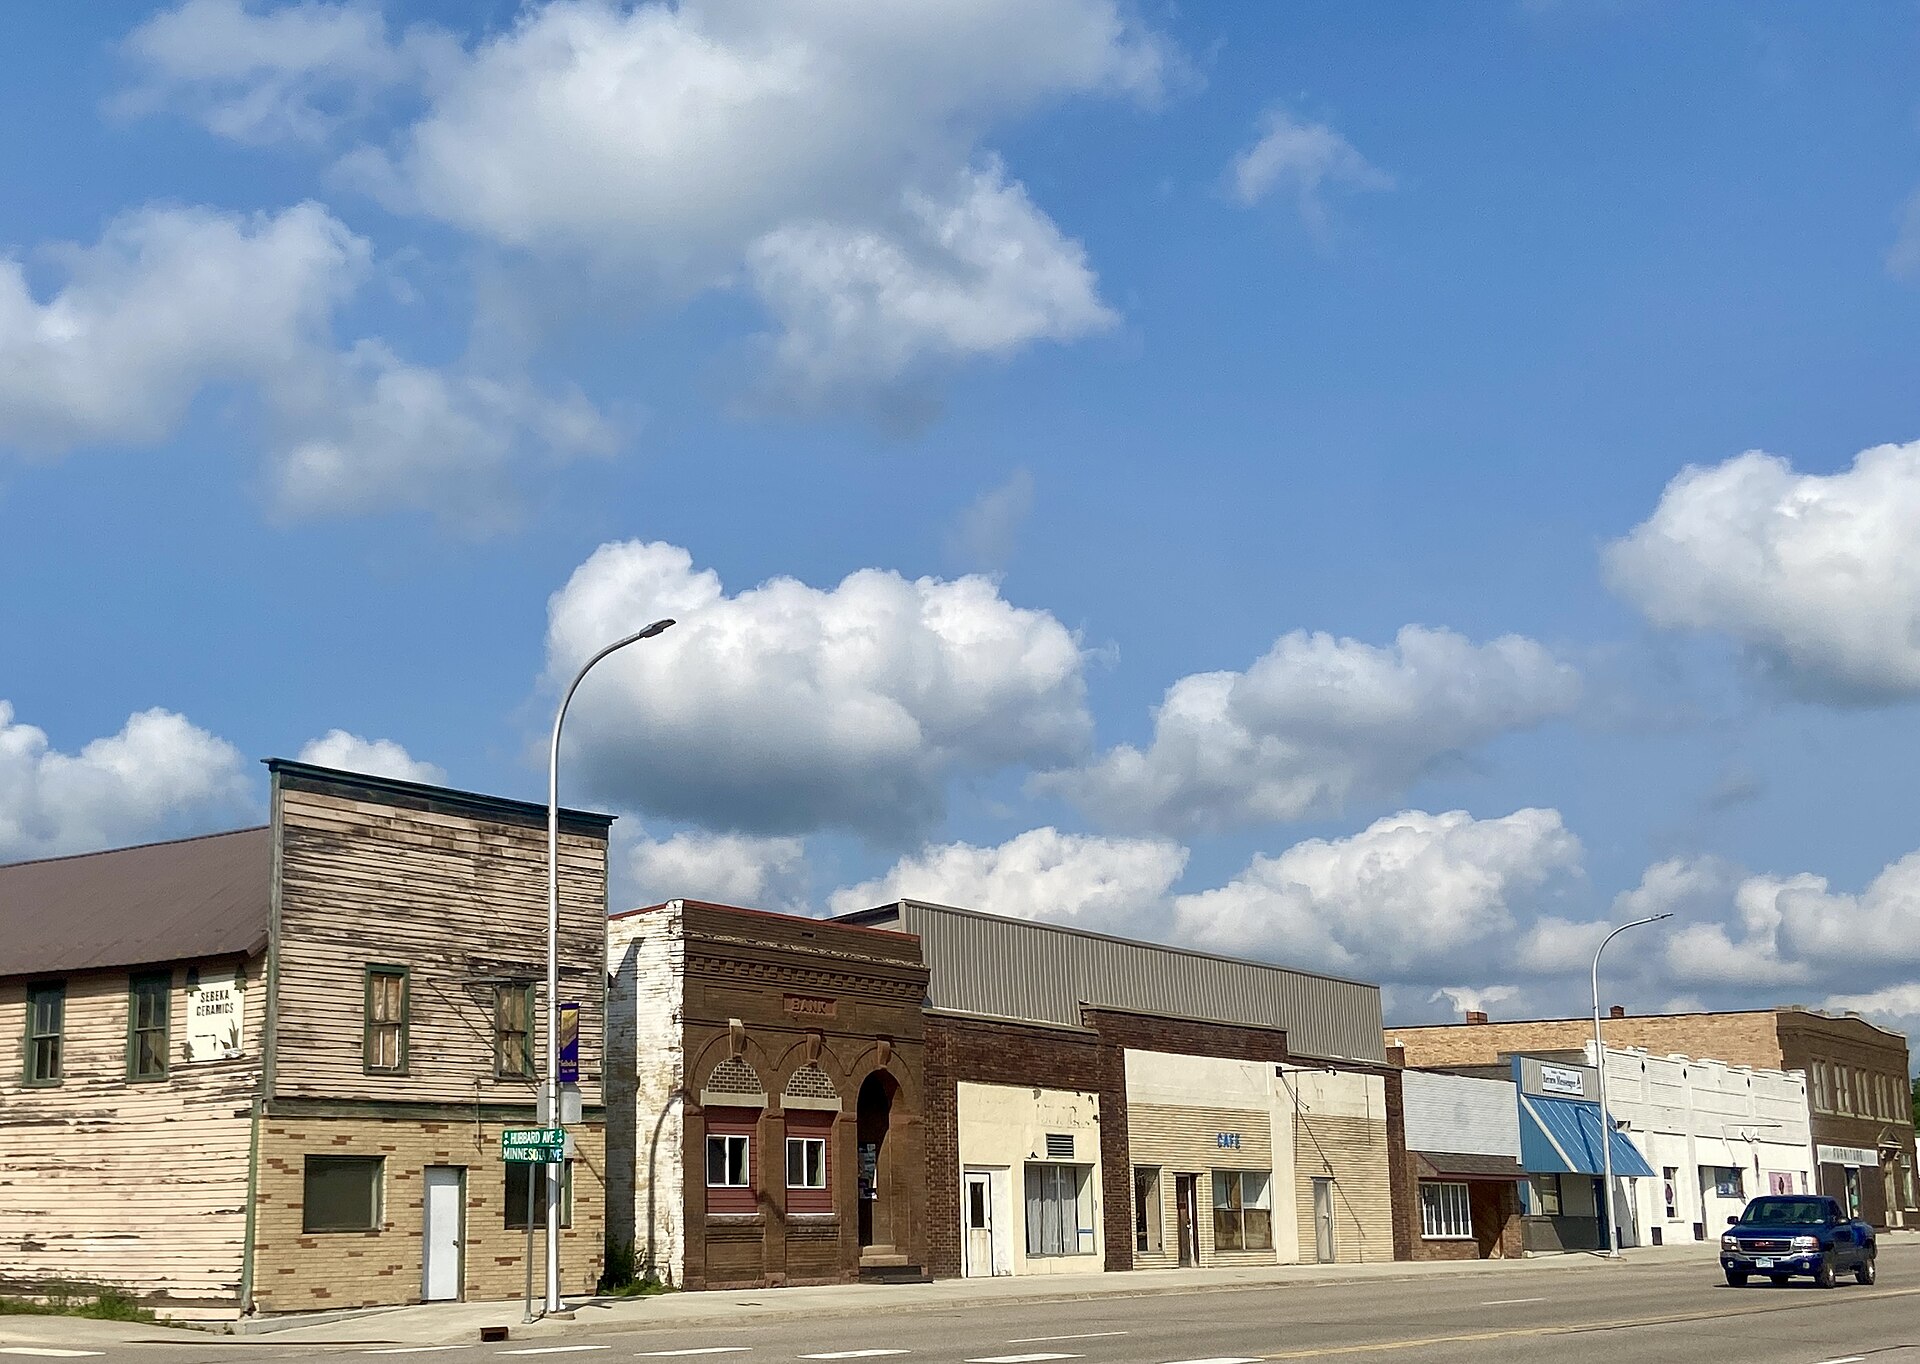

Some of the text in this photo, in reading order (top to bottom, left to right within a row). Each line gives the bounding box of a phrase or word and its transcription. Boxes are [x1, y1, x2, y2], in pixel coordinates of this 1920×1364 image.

[200, 989, 230, 1003] SEBEKA
[196, 1002, 234, 1017] CERAMICS
[791, 998, 826, 1014] BANK
[510, 1131, 541, 1145] HUBBARD
[541, 1130, 556, 1144] AVE
[1216, 1132, 1241, 1149] CAFE
[503, 1147, 563, 1162] MINNESOTA AVE
